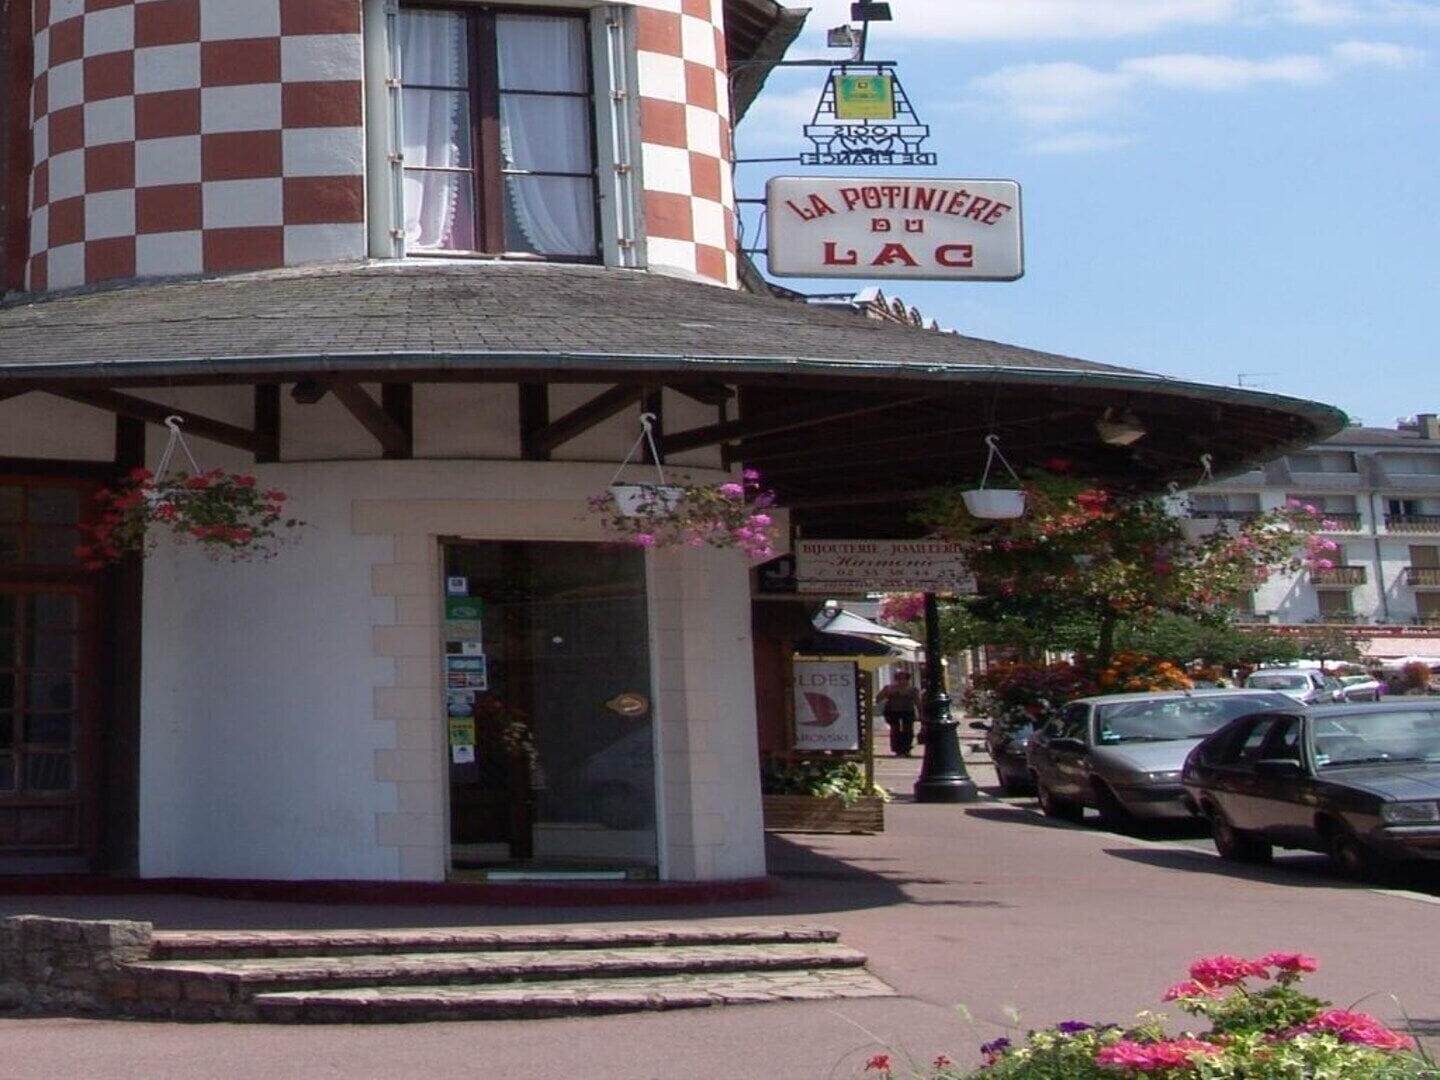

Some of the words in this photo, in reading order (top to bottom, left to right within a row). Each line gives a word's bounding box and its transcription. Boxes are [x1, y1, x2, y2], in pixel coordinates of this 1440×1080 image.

[785, 194, 836, 221] LA
[872, 218, 924, 232] DU
[823, 242, 973, 267] LAC
